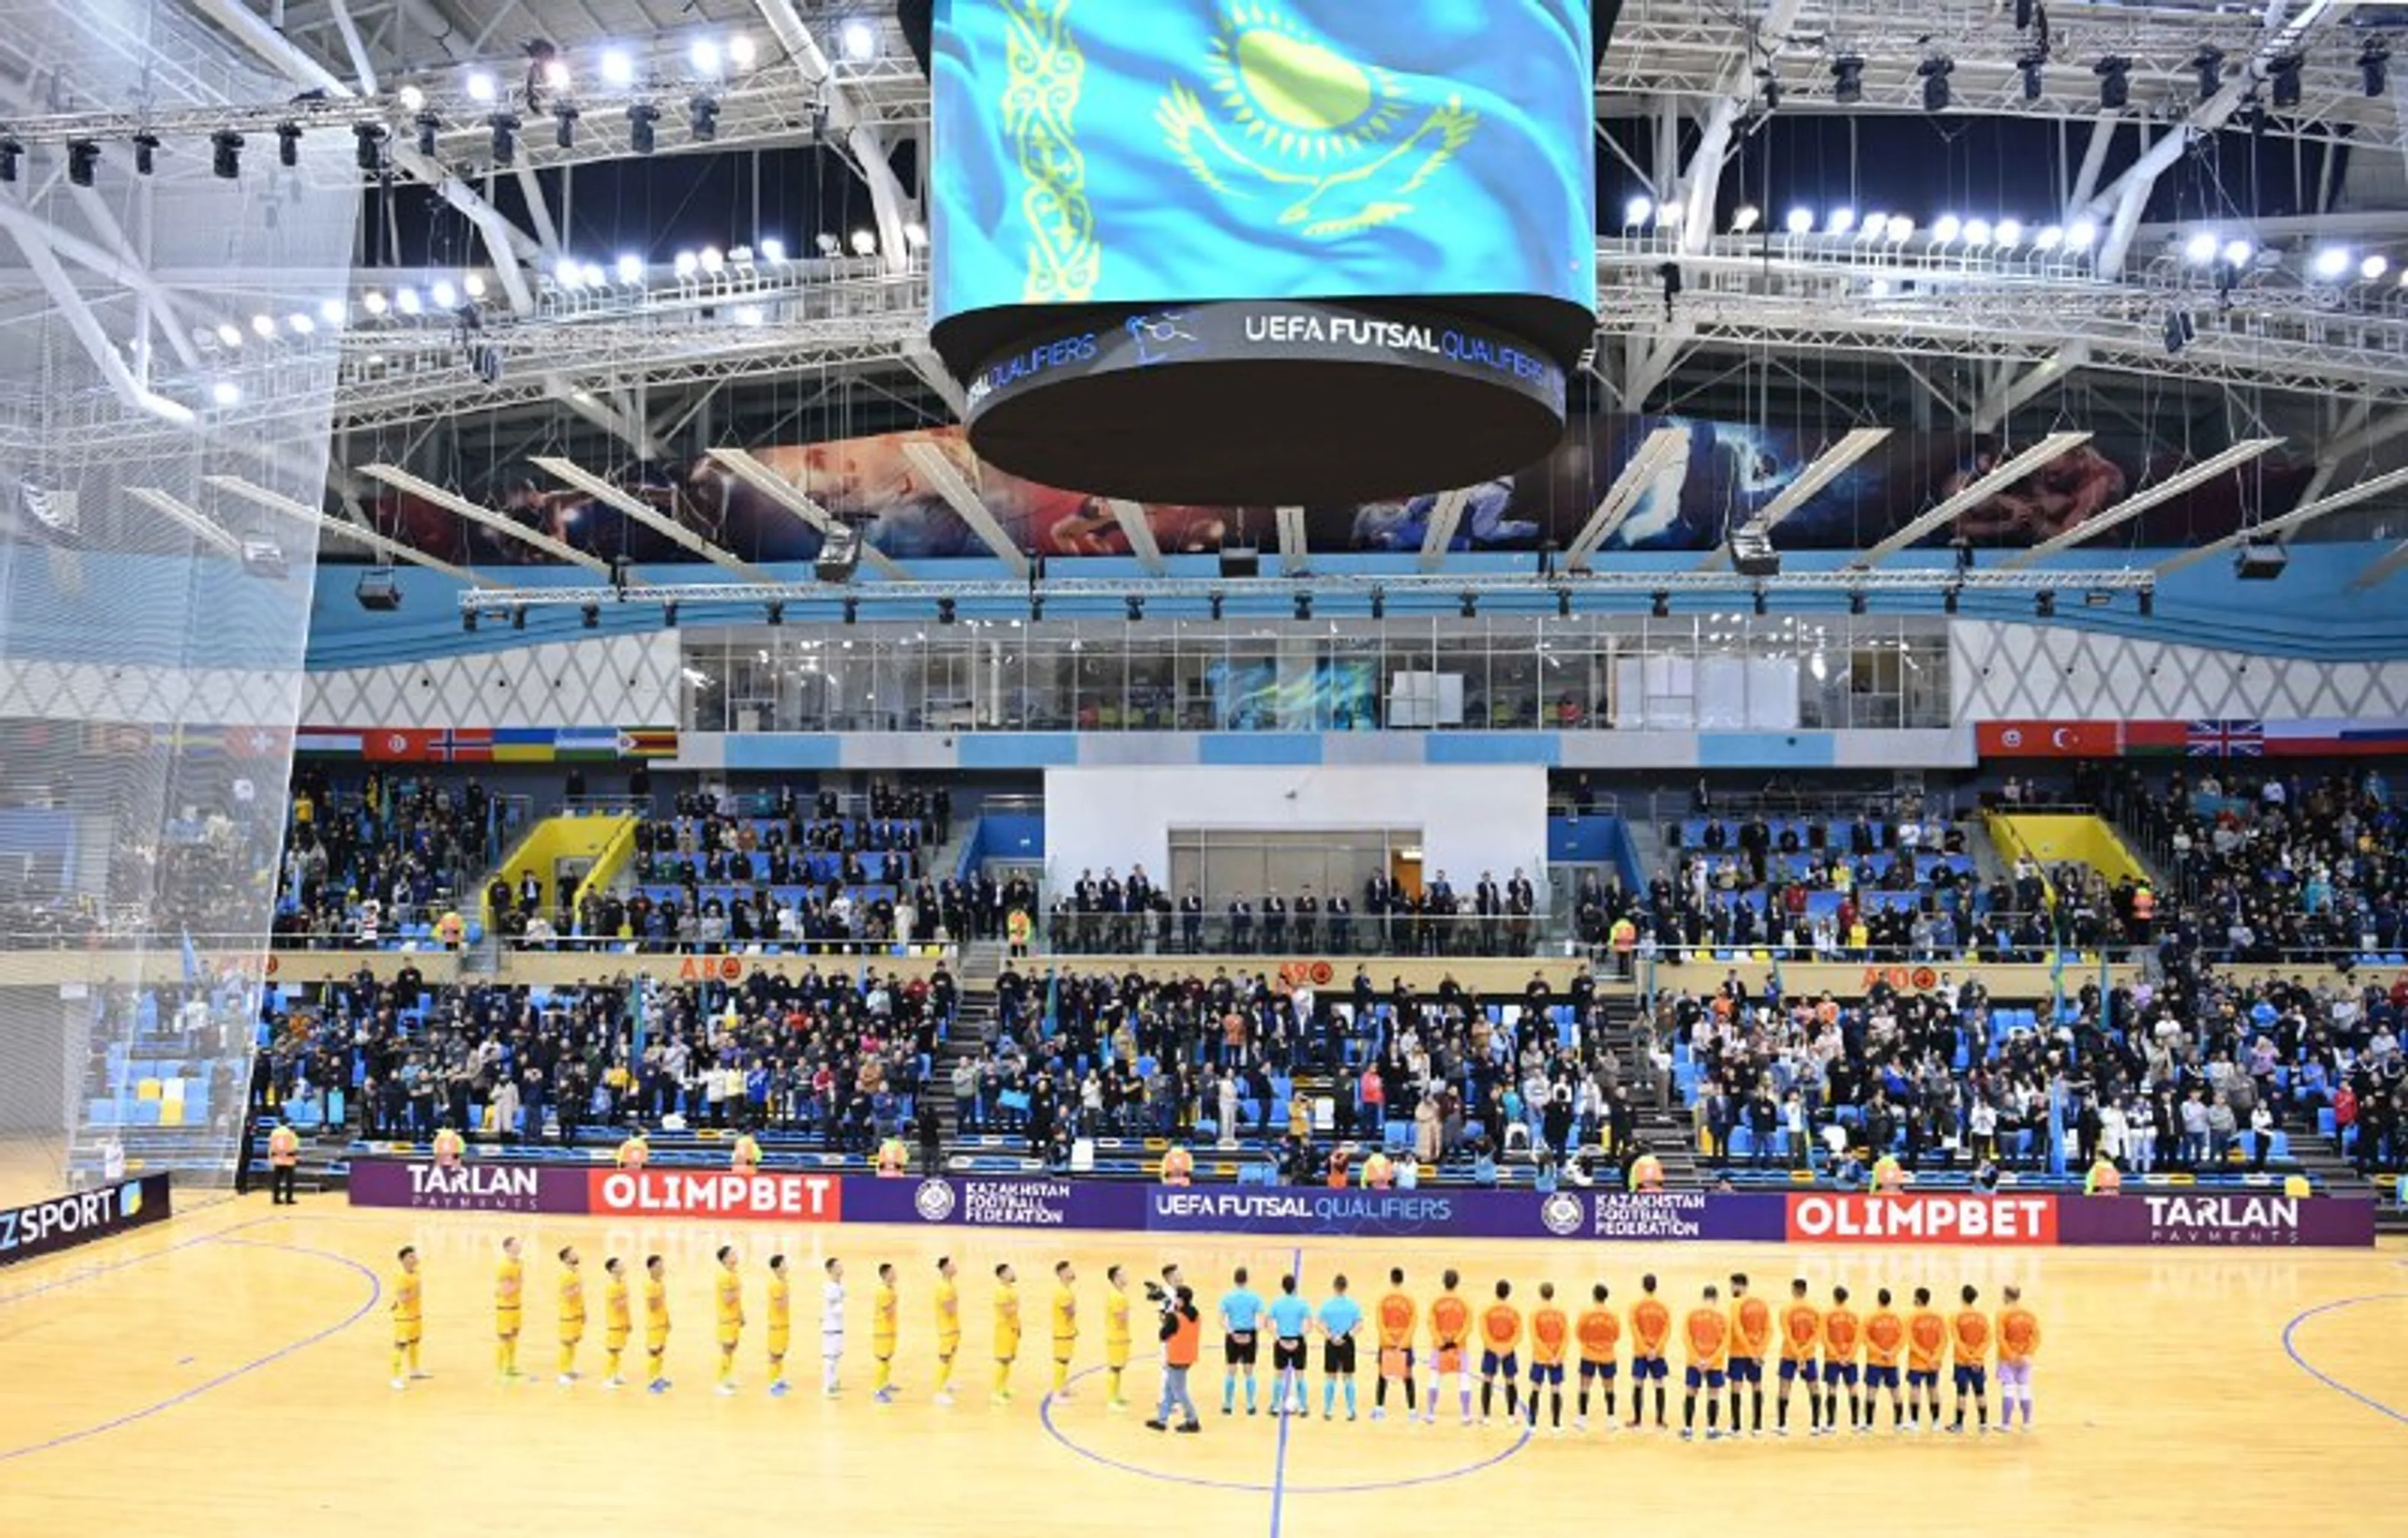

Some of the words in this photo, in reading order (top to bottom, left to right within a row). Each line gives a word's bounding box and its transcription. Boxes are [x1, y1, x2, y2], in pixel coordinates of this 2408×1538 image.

[990, 333, 1097, 389] QUALIFIERS
[1245, 315, 1326, 342] UEFA
[1330, 317, 1440, 354] FUTSAL
[1442, 330, 1543, 387] QUALIFIERS
[407, 1164, 539, 1195] TARLAN
[965, 1182, 1070, 1198] KAZAKHSTAN
[603, 1174, 830, 1213] OLIMPBET
[965, 1196, 1046, 1210] FOOTBALL
[1595, 1194, 1706, 1209] KAZAKHSTAN
[965, 1209, 1064, 1223] FEDERATION
[1156, 1194, 1215, 1215] UEFA
[1218, 1195, 1312, 1218] FUTSAL
[1315, 1197, 1452, 1221] QUALIFIERS
[1595, 1208, 1678, 1221] FOOTBALL
[1796, 1198, 2047, 1236] OLIMPBET
[2145, 1197, 2298, 1228] TARLAN
[1595, 1222, 1699, 1236] FEDERATION
